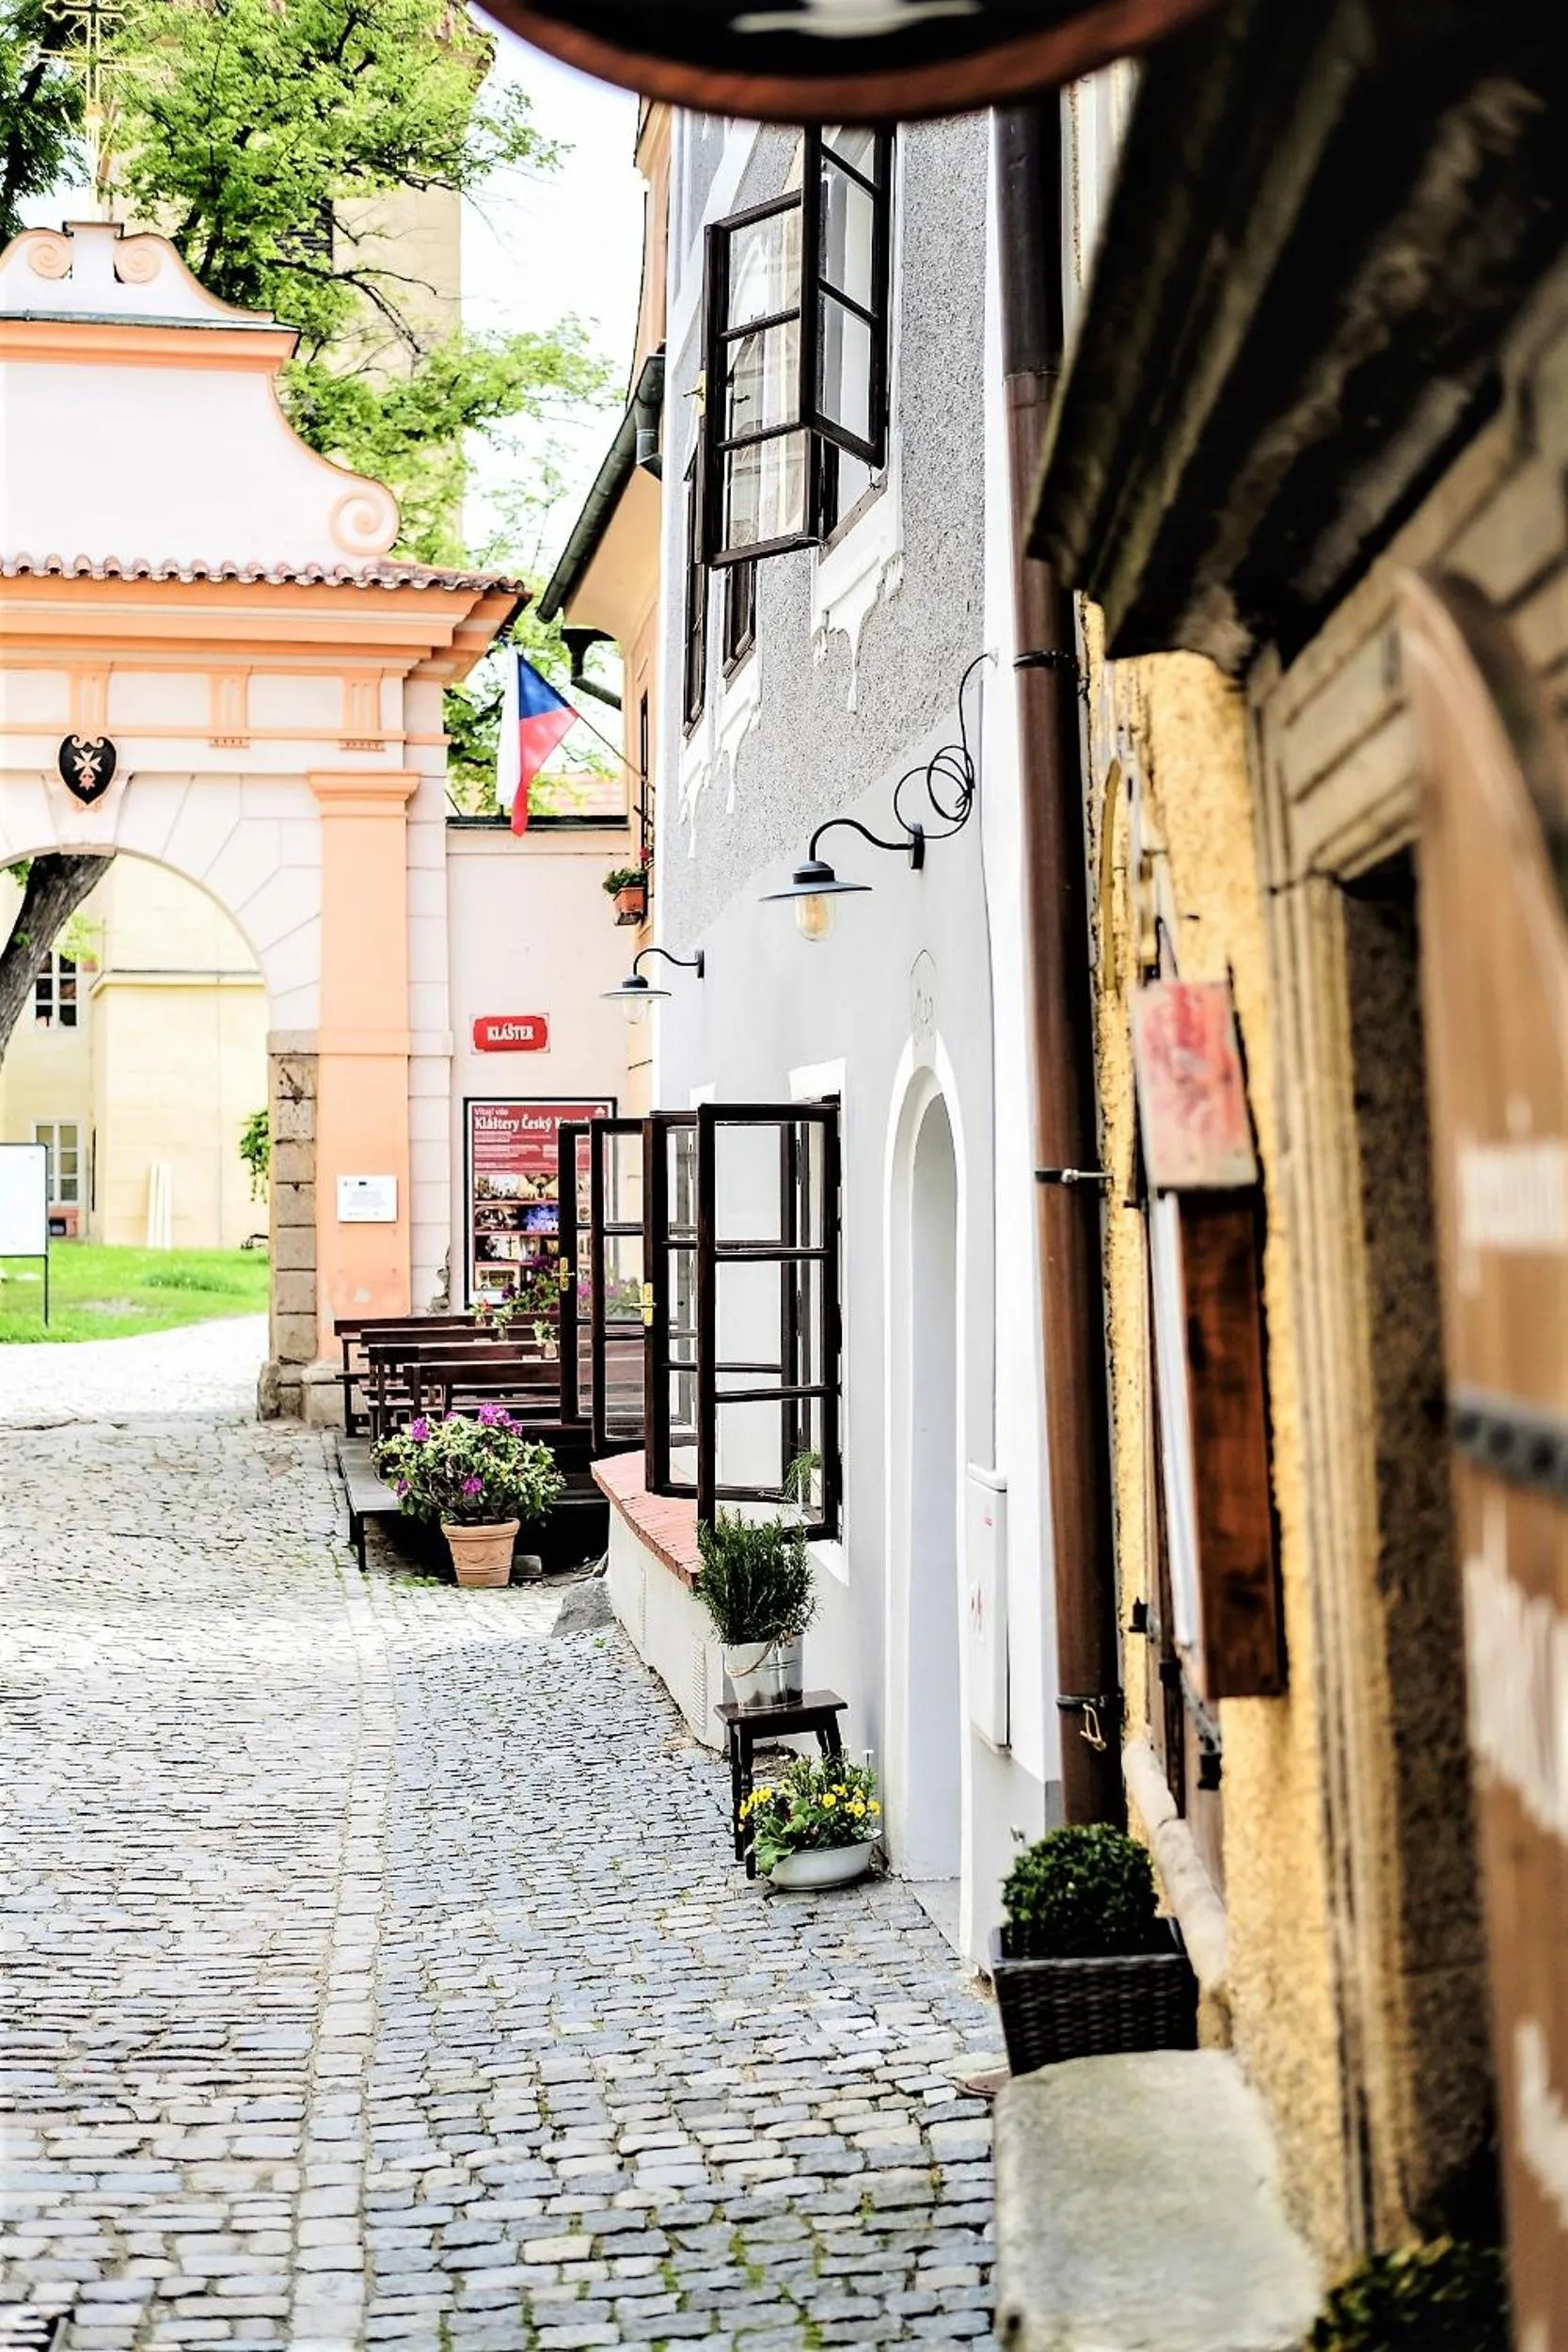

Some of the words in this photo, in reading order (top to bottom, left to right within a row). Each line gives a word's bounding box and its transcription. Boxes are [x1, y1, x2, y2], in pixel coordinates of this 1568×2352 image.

[487, 1023, 534, 1041] KLÁŠTER
[474, 1116, 519, 1133] Kláštery
[521, 1114, 552, 1133] Český
